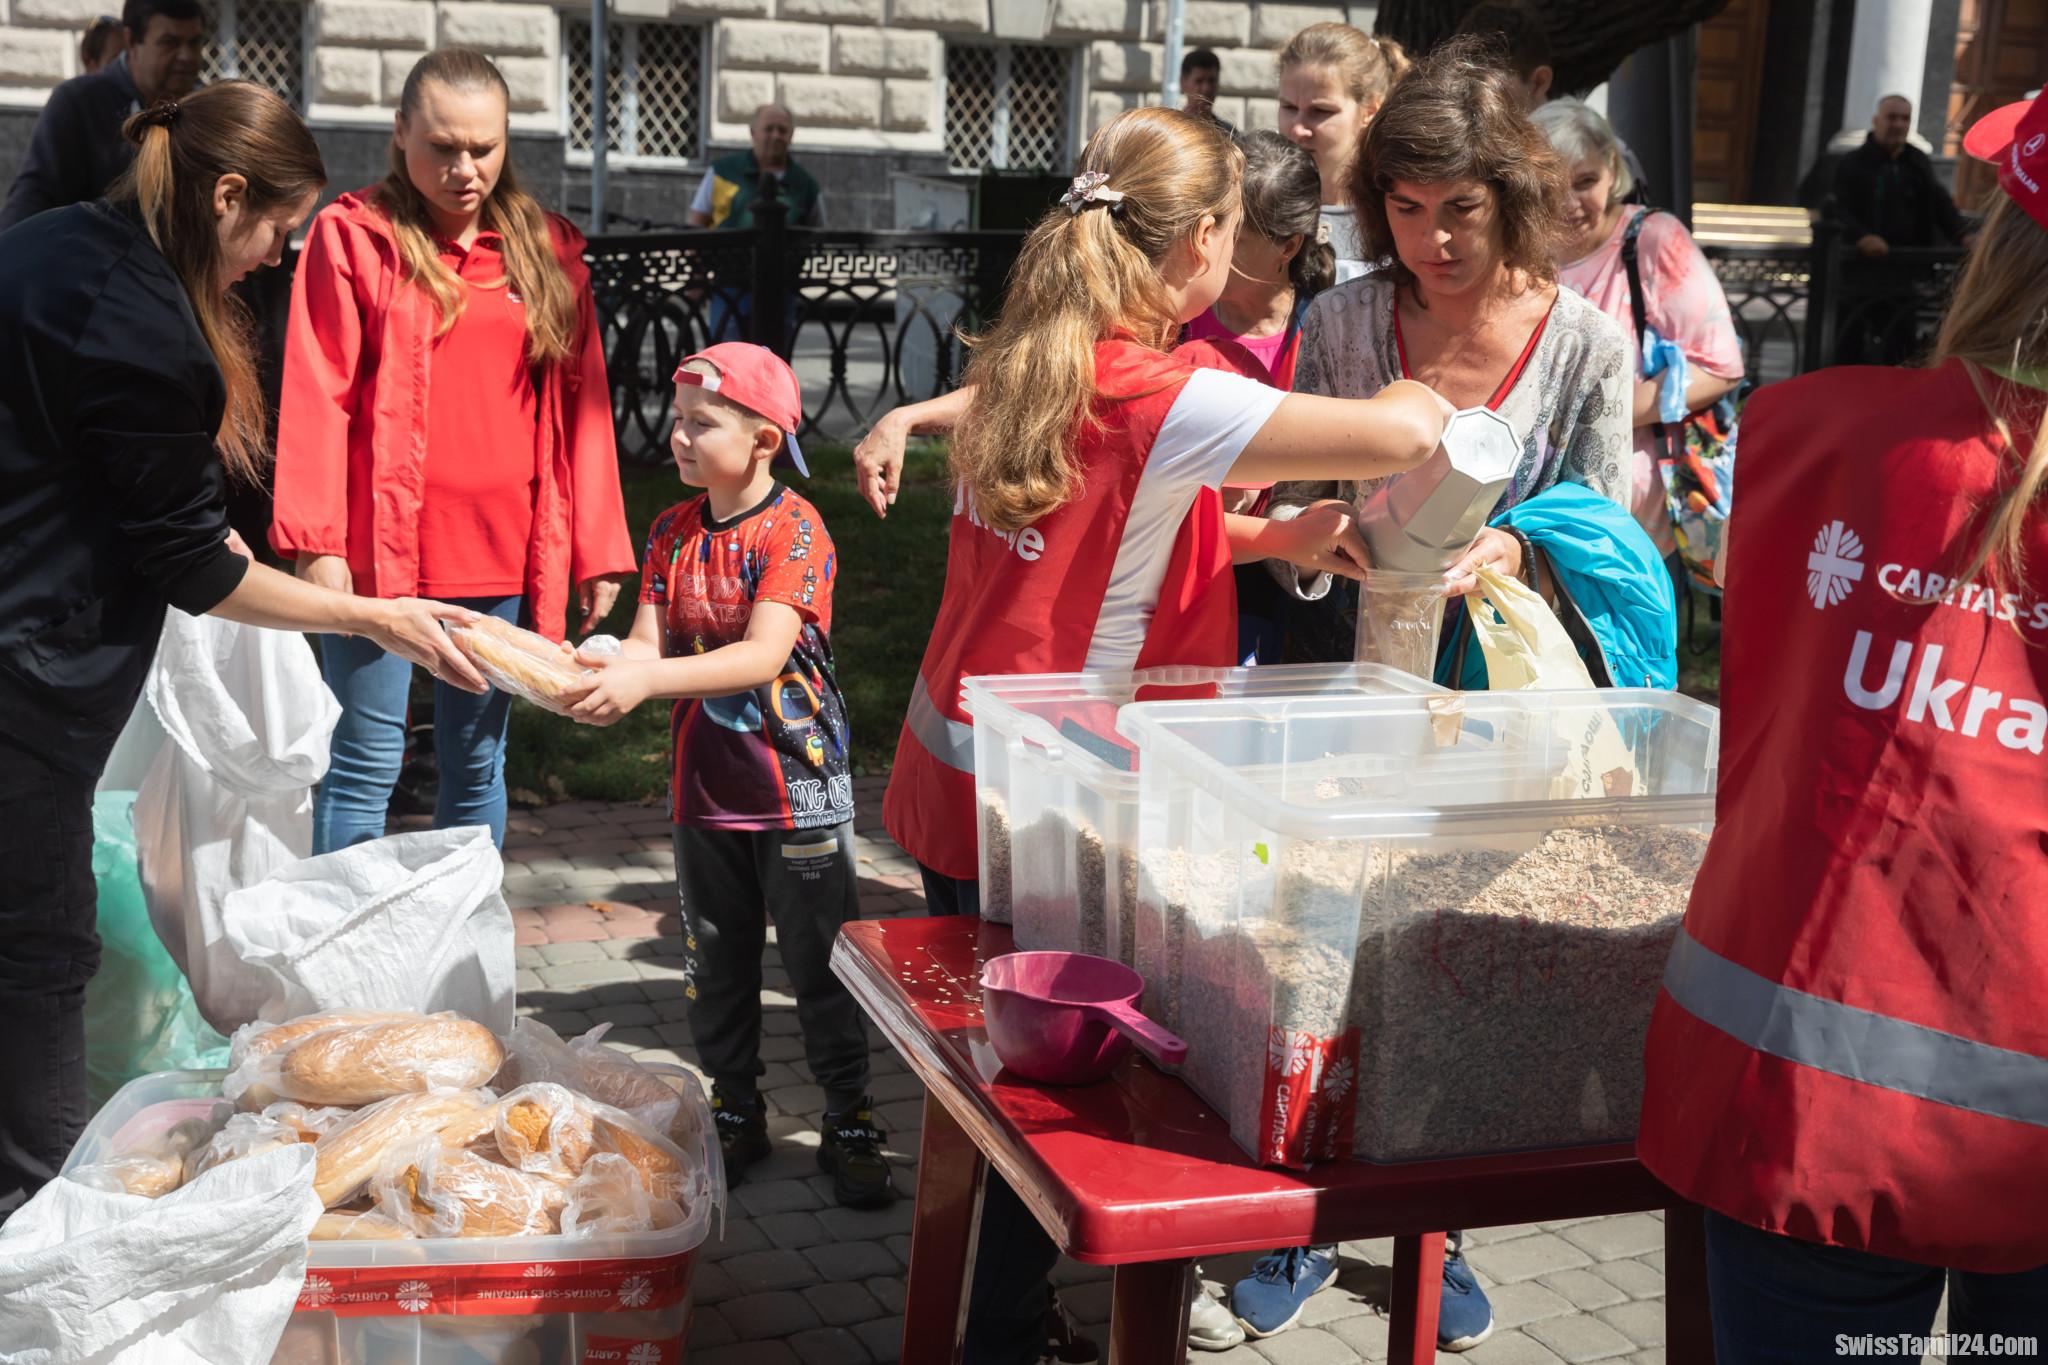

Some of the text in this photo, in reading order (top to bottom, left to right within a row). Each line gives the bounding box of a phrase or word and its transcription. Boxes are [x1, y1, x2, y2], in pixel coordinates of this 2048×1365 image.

[1843, 629, 2048, 755] Ukra
[786, 778, 827, 812] ONG
[477, 1288, 611, 1299] CARITAS-SPES UKRAINE
